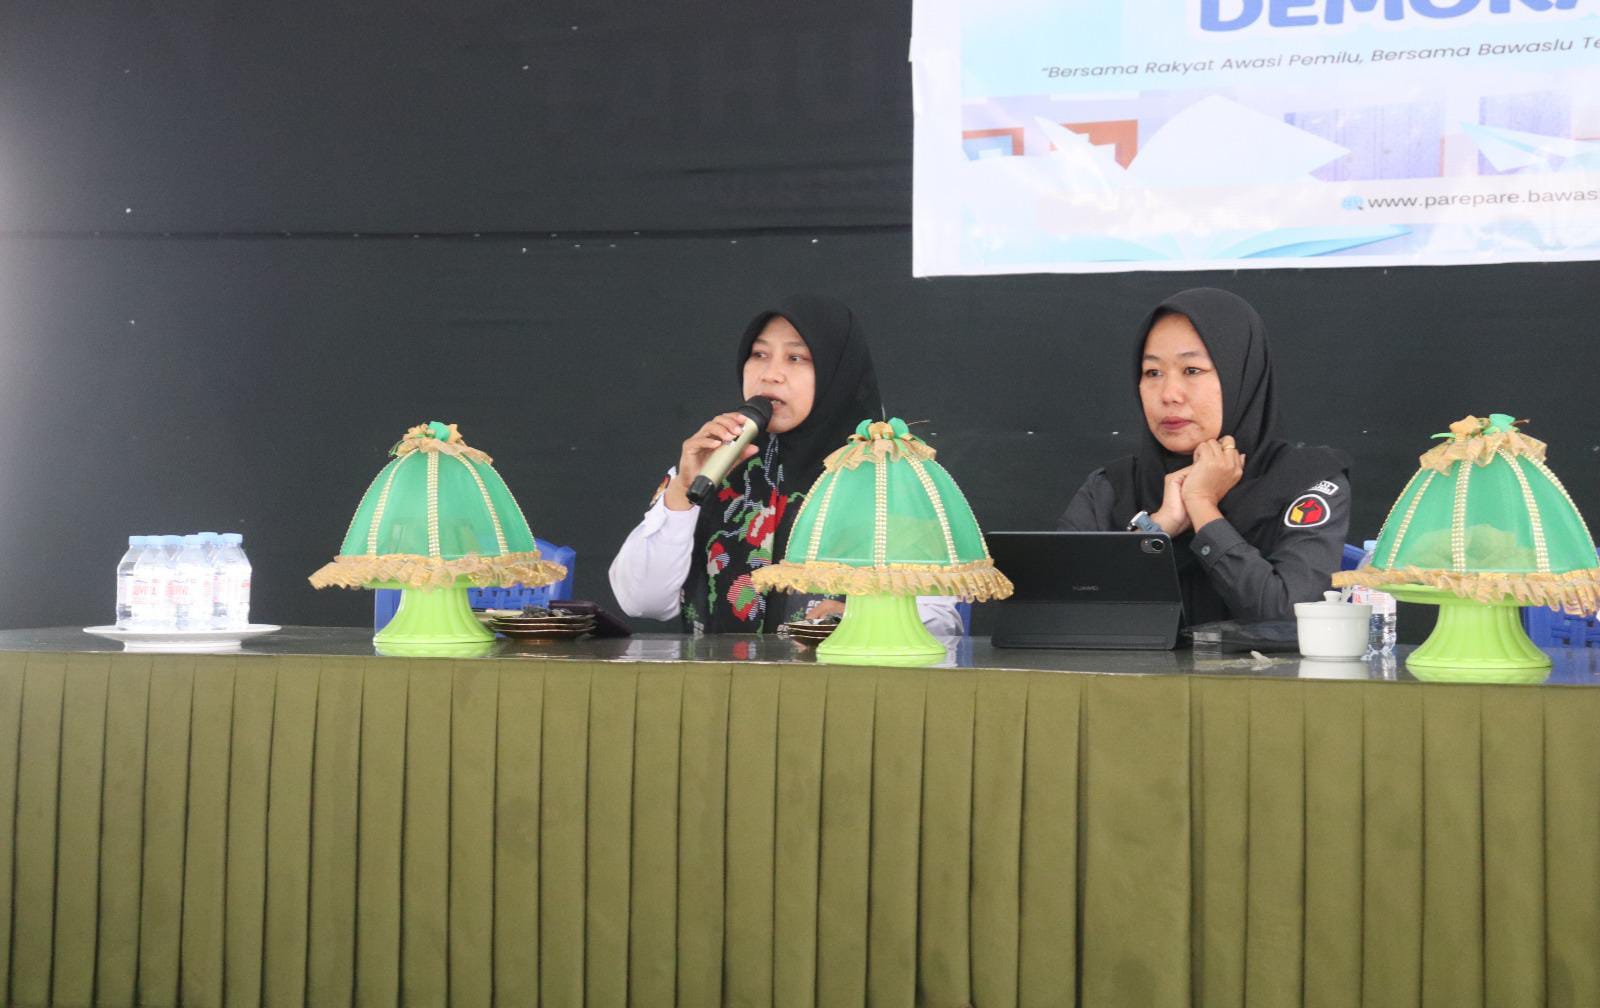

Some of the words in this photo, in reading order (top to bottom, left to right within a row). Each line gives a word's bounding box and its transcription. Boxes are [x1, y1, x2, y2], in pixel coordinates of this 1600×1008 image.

[1199, 0, 1579, 32] DEM
[1144, 59, 1215, 77] Rakyat
[1220, 54, 1283, 70] Awasi
[1288, 51, 1365, 68] Pemilu,
[1371, 46, 1471, 62] Bersama
[1477, 38, 1574, 57] Bawaslu
[1367, 189, 1600, 209] www.parepare.bawas
